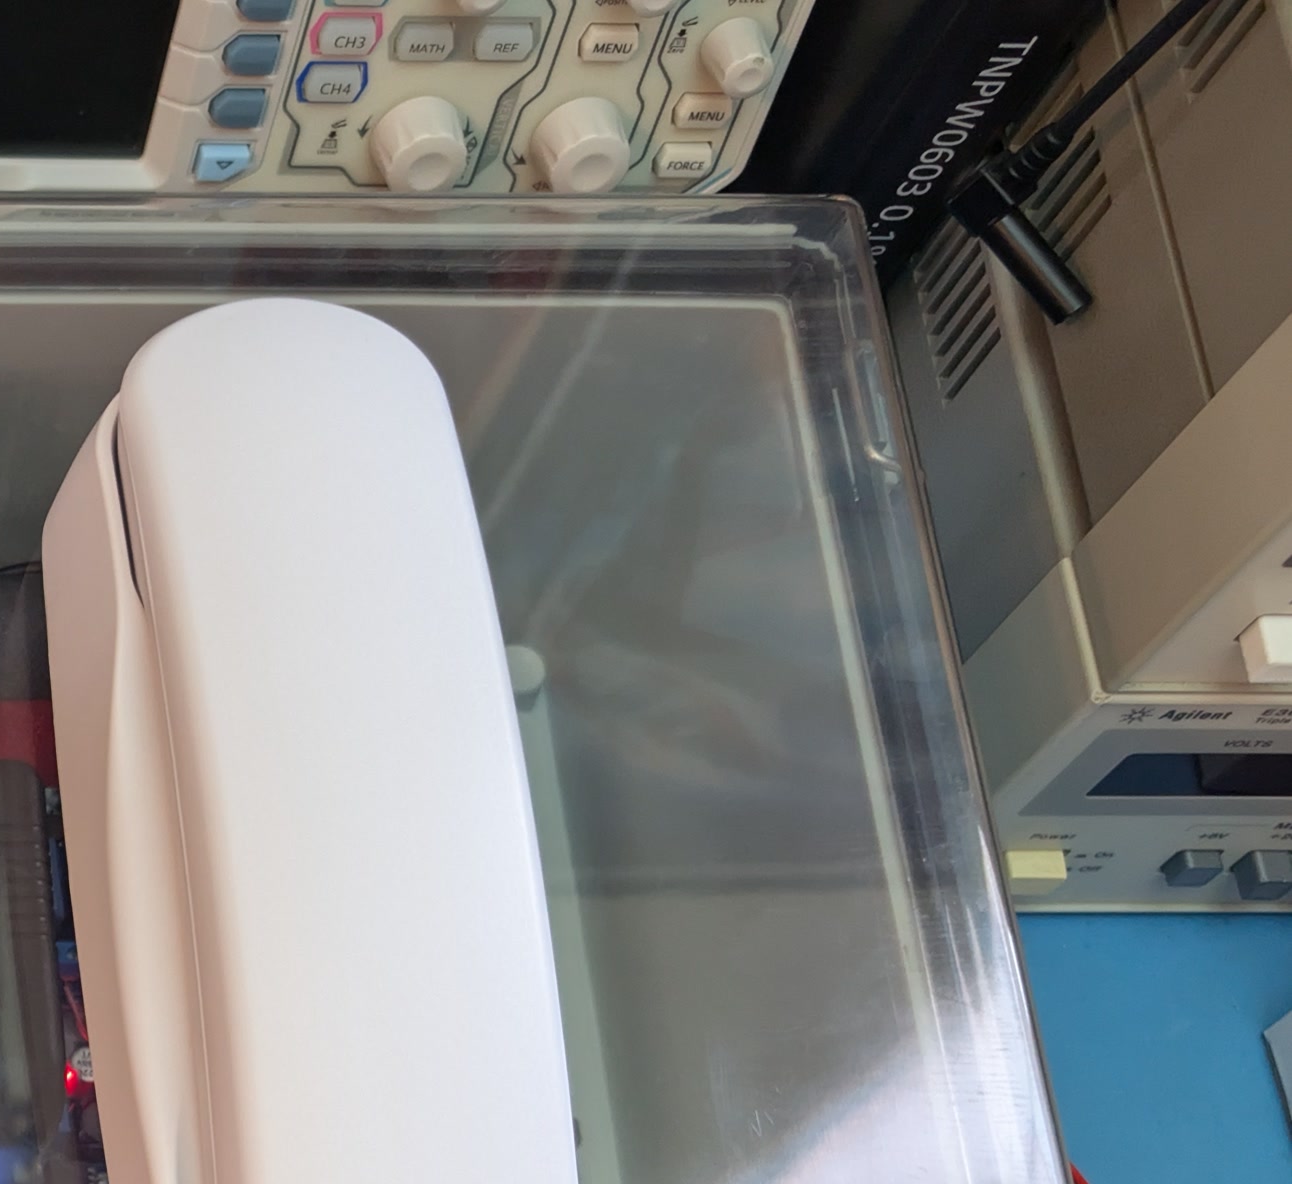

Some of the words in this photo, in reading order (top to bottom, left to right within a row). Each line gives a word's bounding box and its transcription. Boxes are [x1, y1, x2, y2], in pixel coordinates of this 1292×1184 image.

[332, 35, 367, 50] CH3
[408, 42, 447, 55] MATH
[492, 42, 521, 55] REF
[592, 43, 633, 55] MENU
[319, 82, 353, 96] CH4
[687, 109, 726, 123] MENU
[895, 35, 1039, 198] TNPW0603
[666, 160, 706, 172] FORCE
[1157, 704, 1234, 722] Agilent
[1224, 739, 1275, 748] VOLTS
